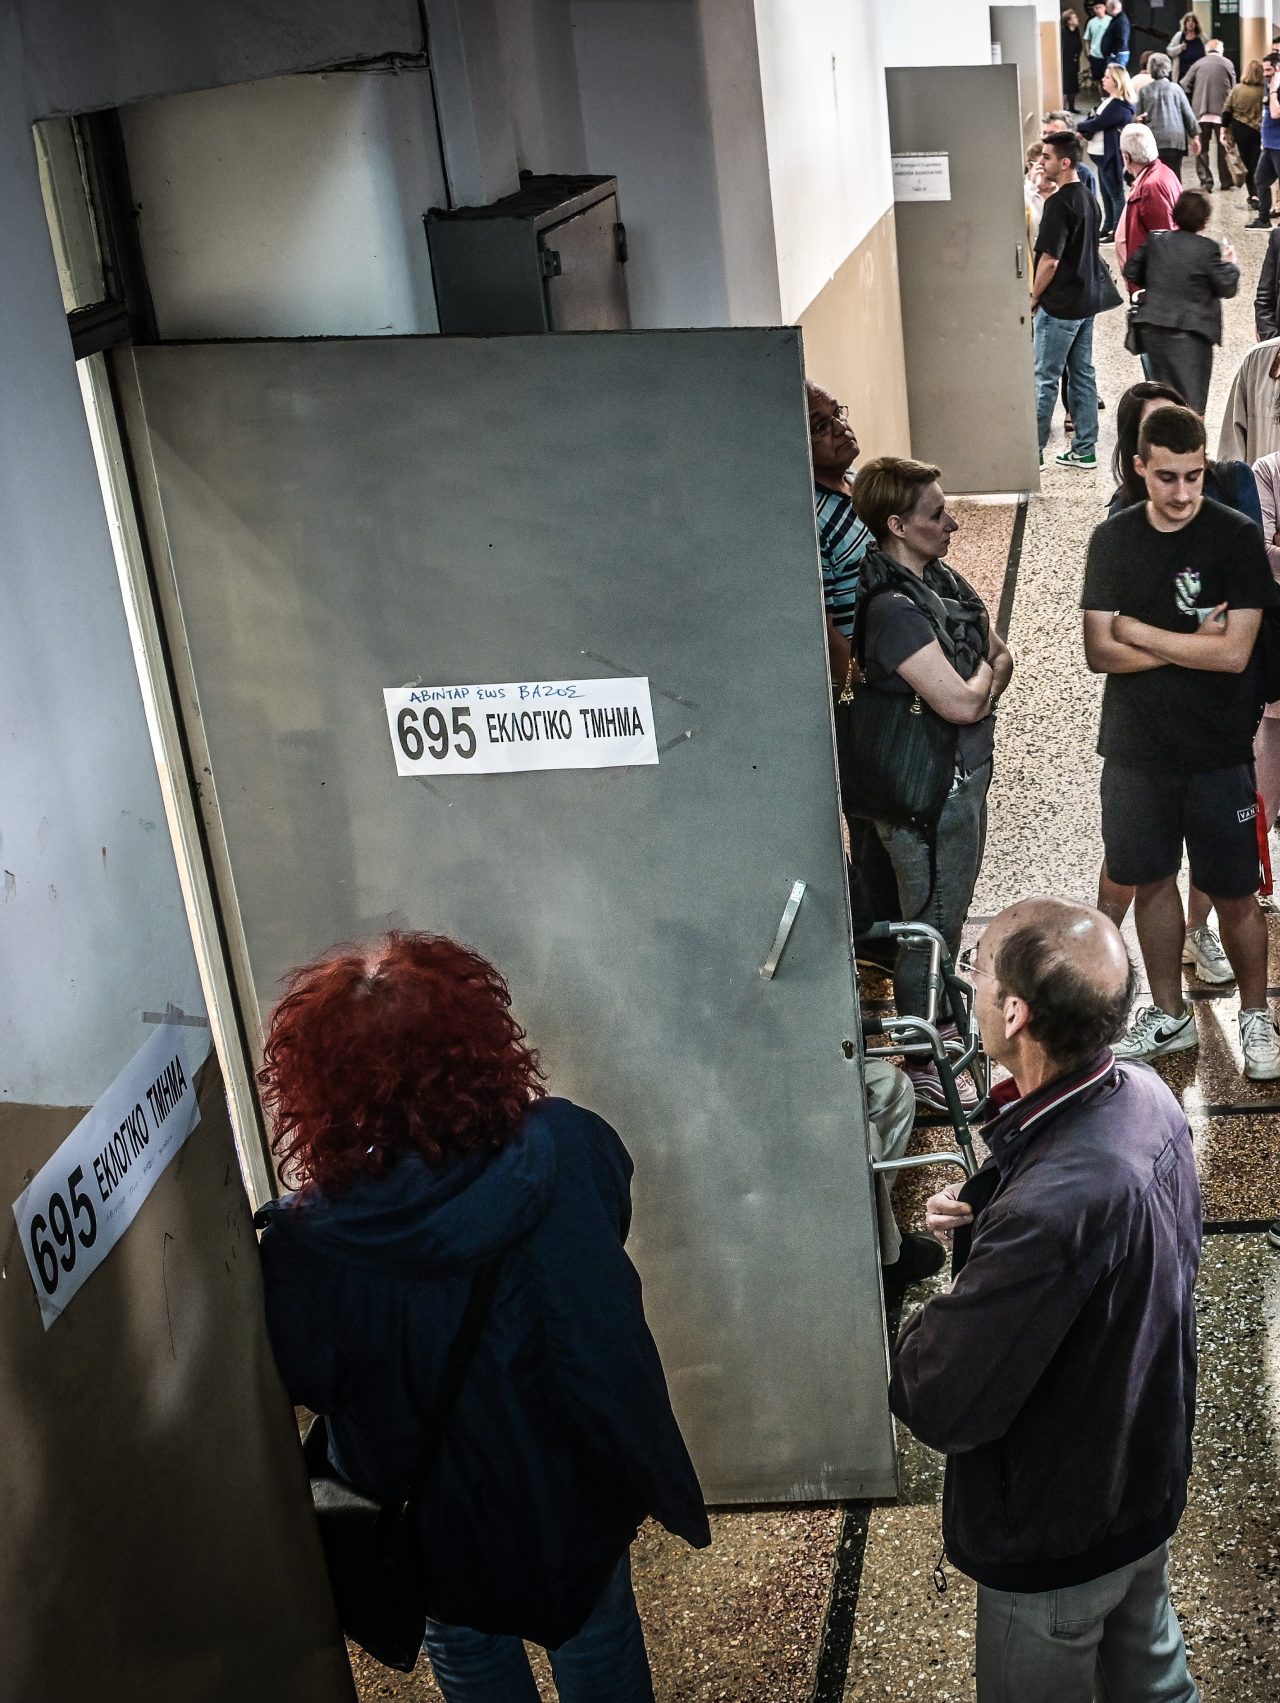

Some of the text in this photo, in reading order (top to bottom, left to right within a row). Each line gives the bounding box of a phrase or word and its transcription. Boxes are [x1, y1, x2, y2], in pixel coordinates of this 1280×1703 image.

[397, 706, 645, 761] 695 ΕΚΛΟΓΙΚΟ ΤΜΗΜΑ
[30, 1165, 97, 1295] 695
[92, 1103, 149, 1202] ΕΚΛΟΓΙΚΟ
[146, 1054, 188, 1129] ΤΜΗΜΑ
